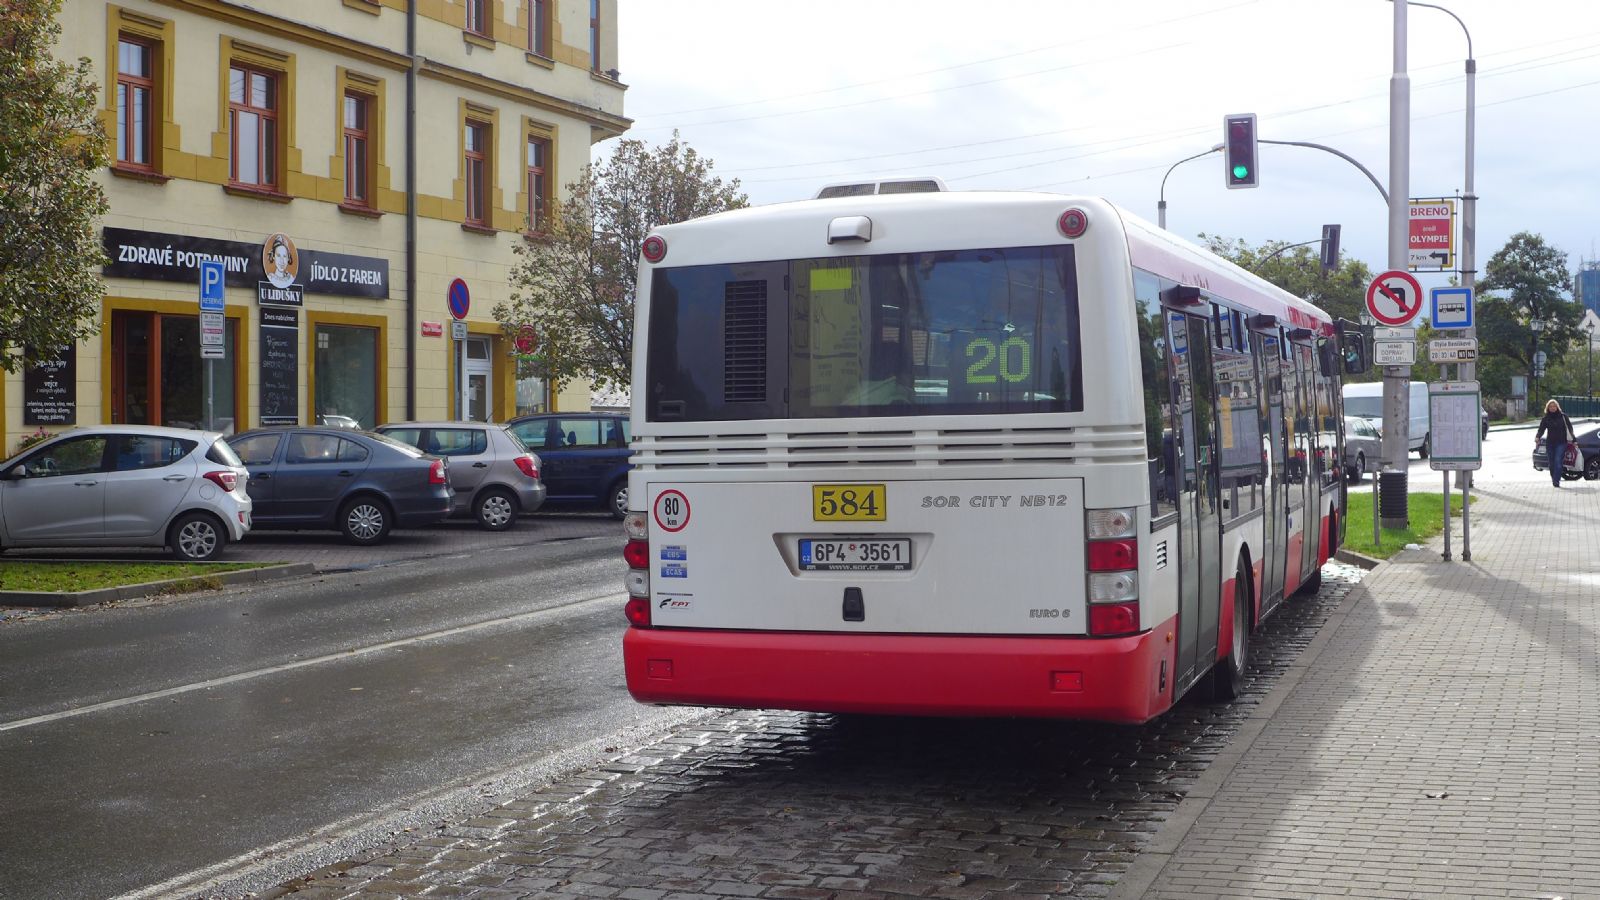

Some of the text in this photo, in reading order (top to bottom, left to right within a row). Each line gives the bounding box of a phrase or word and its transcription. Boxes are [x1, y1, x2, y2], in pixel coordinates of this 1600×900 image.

[1410, 207, 1449, 217] BRENO
[1410, 235, 1449, 243] OLYMPIE
[118, 244, 173, 266] ZDRAVÉ
[310, 260, 382, 286] JÍDLO Z FAREM
[205, 266, 220, 295] P
[261, 287, 301, 302] U LIDUŠKY
[264, 312, 275, 321] Dnes
[966, 336, 1031, 384] 20
[664, 497, 680, 516] 80
[820, 489, 879, 516] 584
[920, 494, 1068, 508] SOR CITY NB12
[667, 517, 677, 526] km
[802, 554, 811, 562] CZ
[815, 543, 901, 562] 6P4 3561
[665, 568, 684, 576] ECAS
[1029, 608, 1071, 618] EURO 6
